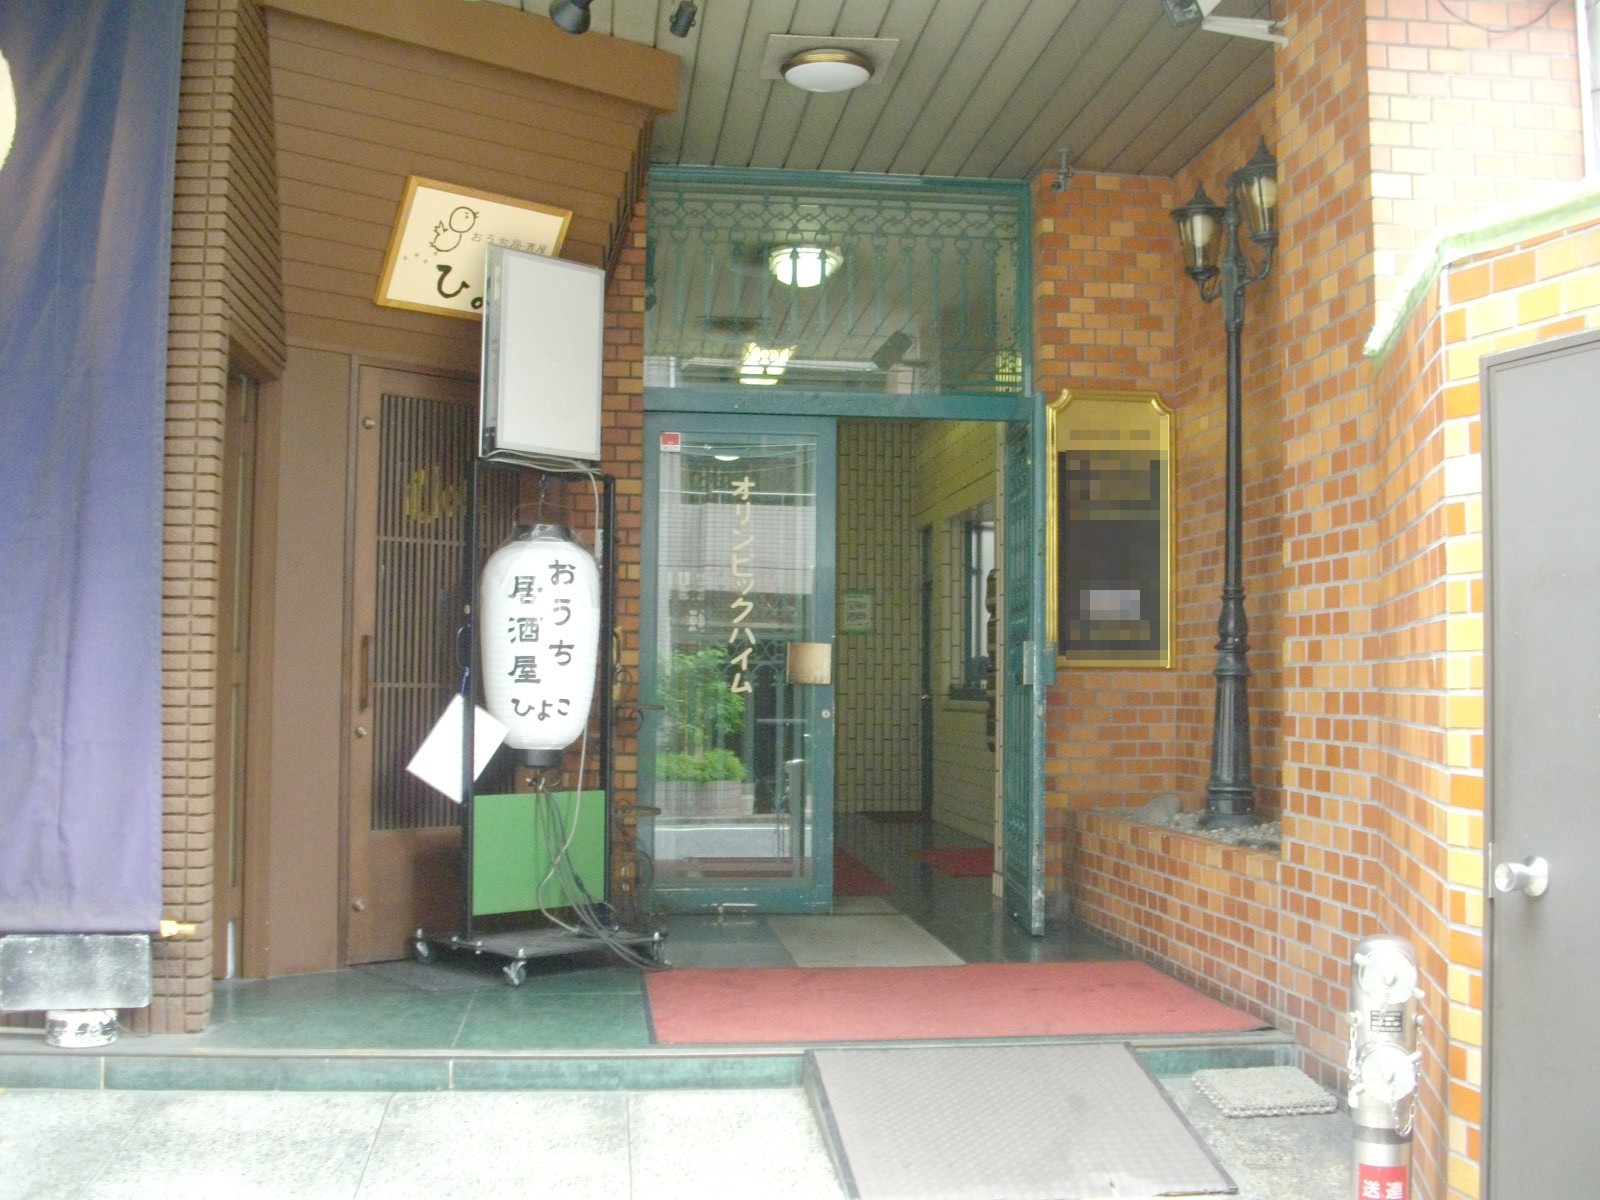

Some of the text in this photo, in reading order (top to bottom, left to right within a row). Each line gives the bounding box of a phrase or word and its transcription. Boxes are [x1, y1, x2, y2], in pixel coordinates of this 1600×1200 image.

[508, 576, 542, 684] 居酒屋
[549, 559, 576, 666] おうち
[511, 698, 570, 721] ひよこ
